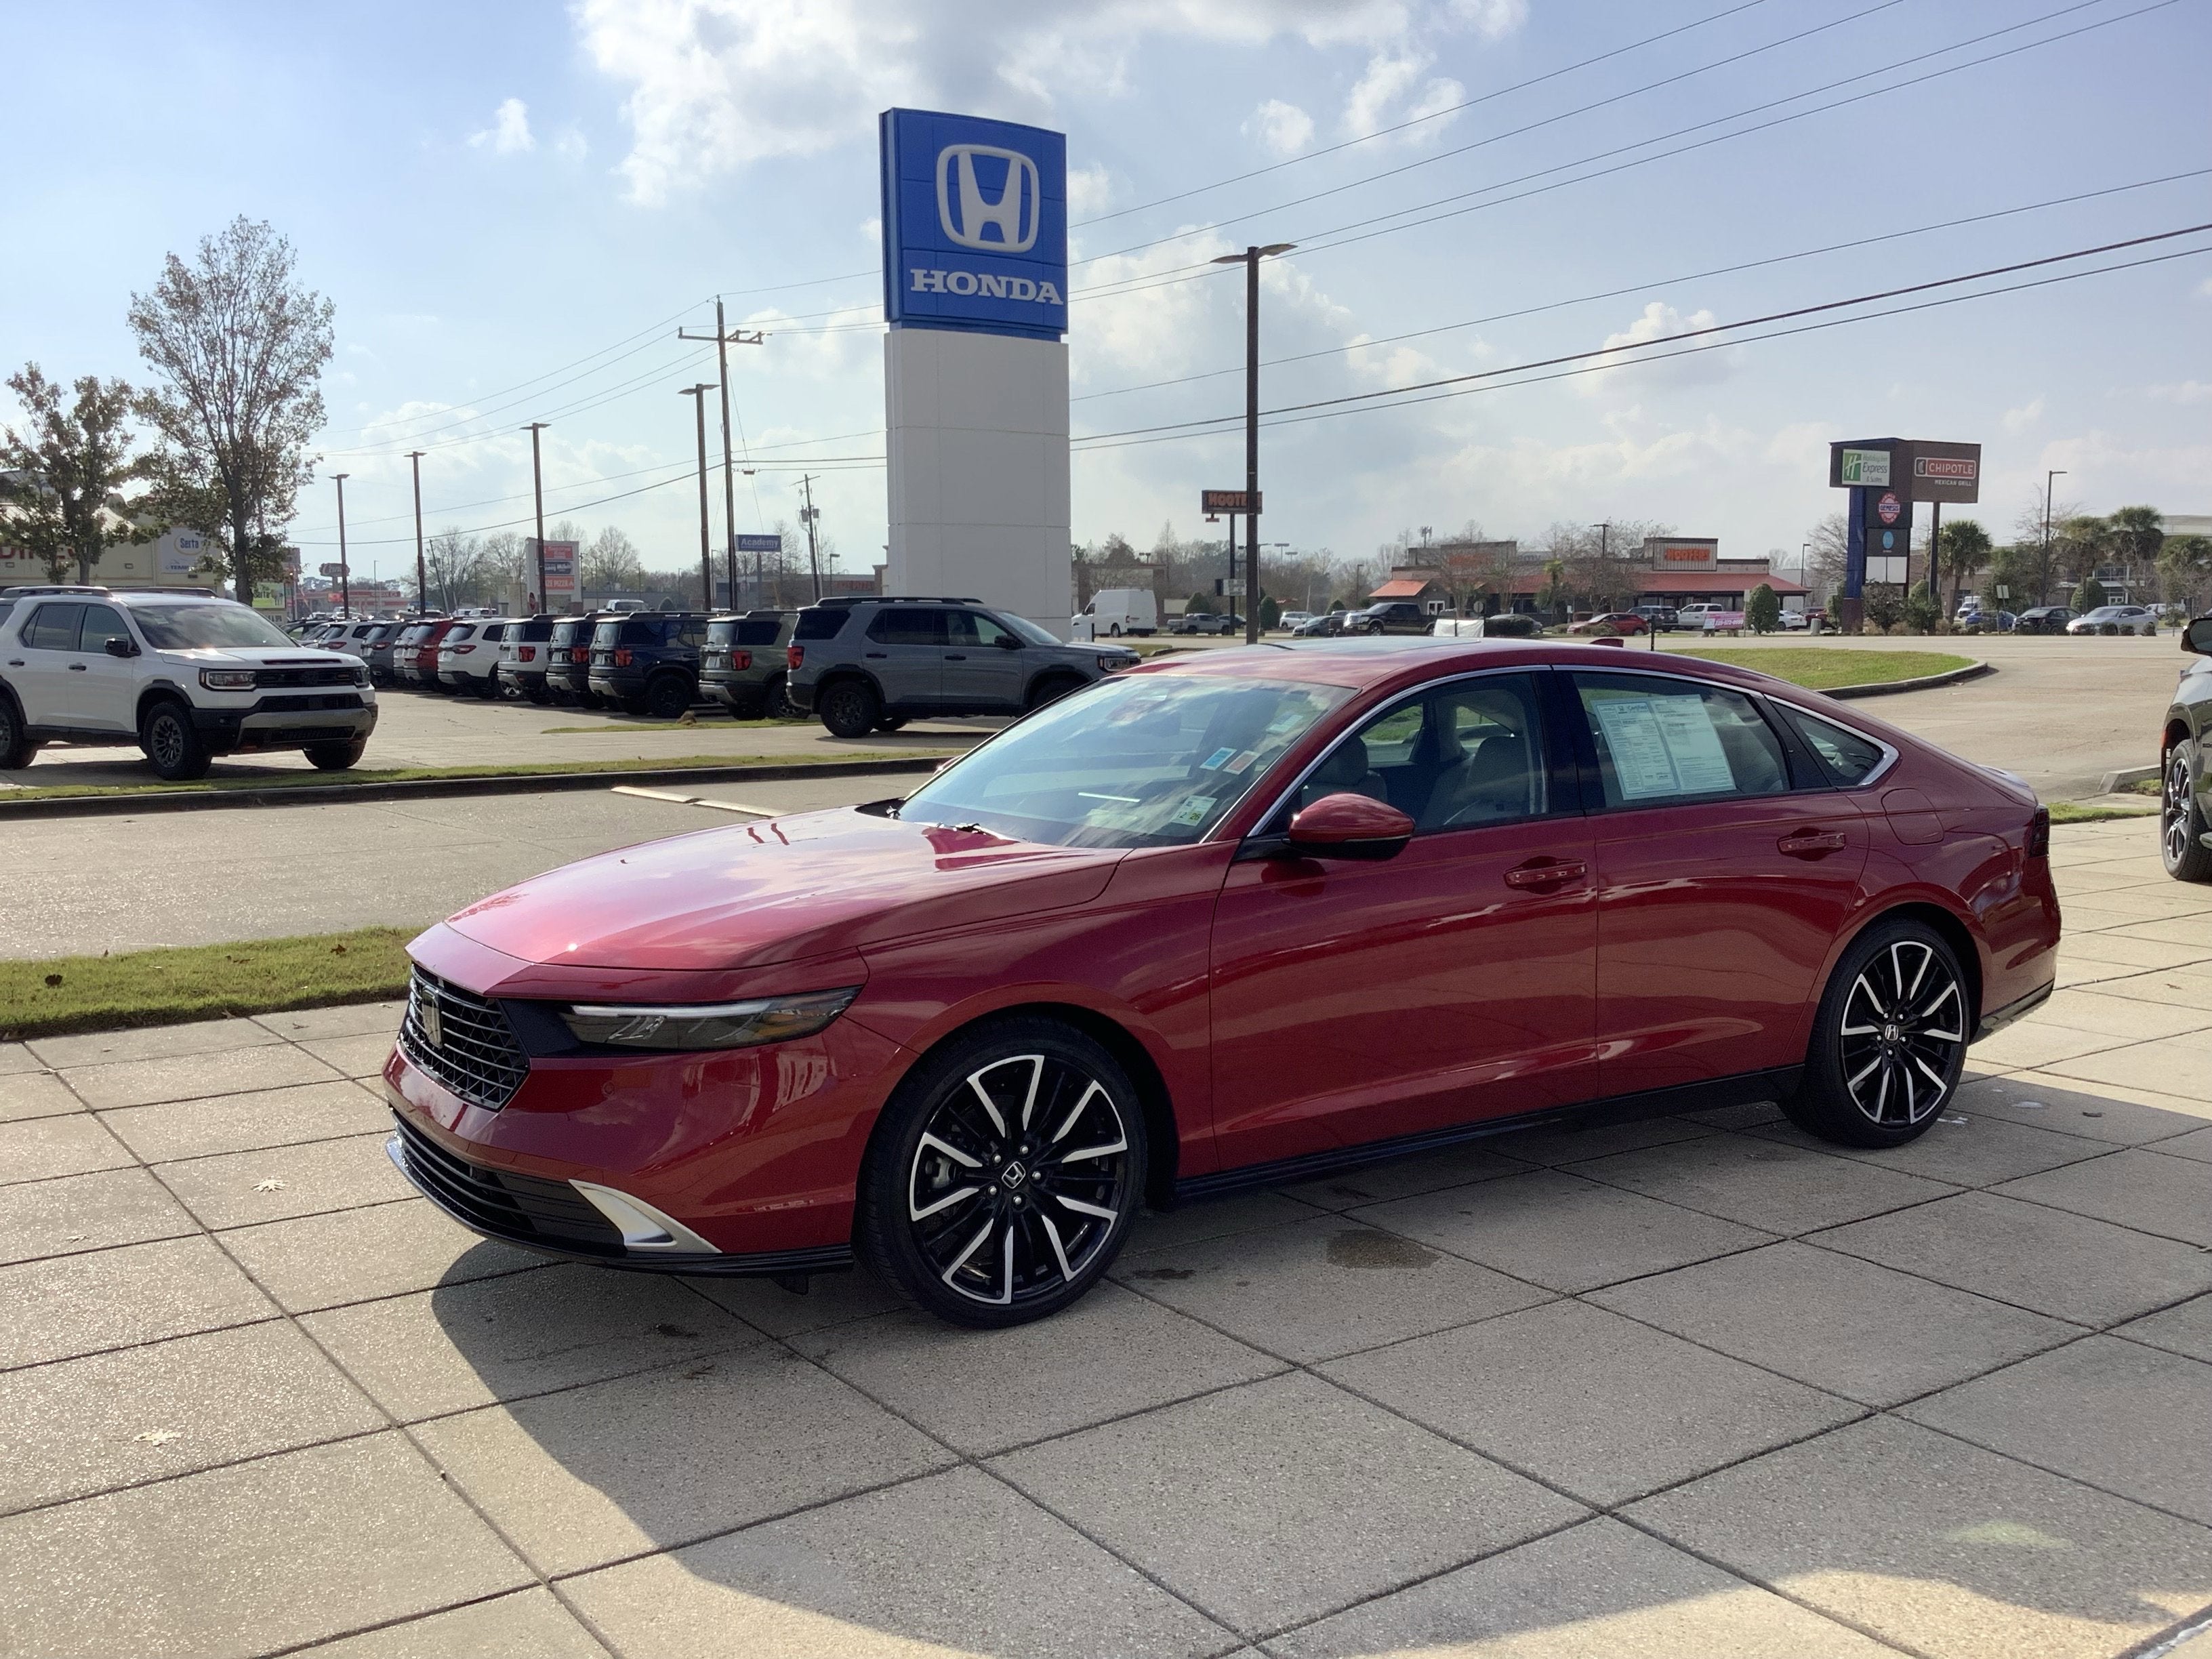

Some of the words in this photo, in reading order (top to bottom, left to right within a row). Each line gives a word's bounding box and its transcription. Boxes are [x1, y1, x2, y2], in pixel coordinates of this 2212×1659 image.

[910, 268, 1063, 305] HONDA
[1862, 462, 1888, 474] Express
[1929, 463, 1974, 474] CHIPOTLE
[1208, 493, 1262, 507] HOOTE
[180, 537, 199, 548] Serta
[741, 537, 779, 548] Academy
[1189, 813, 1202, 821] 26
